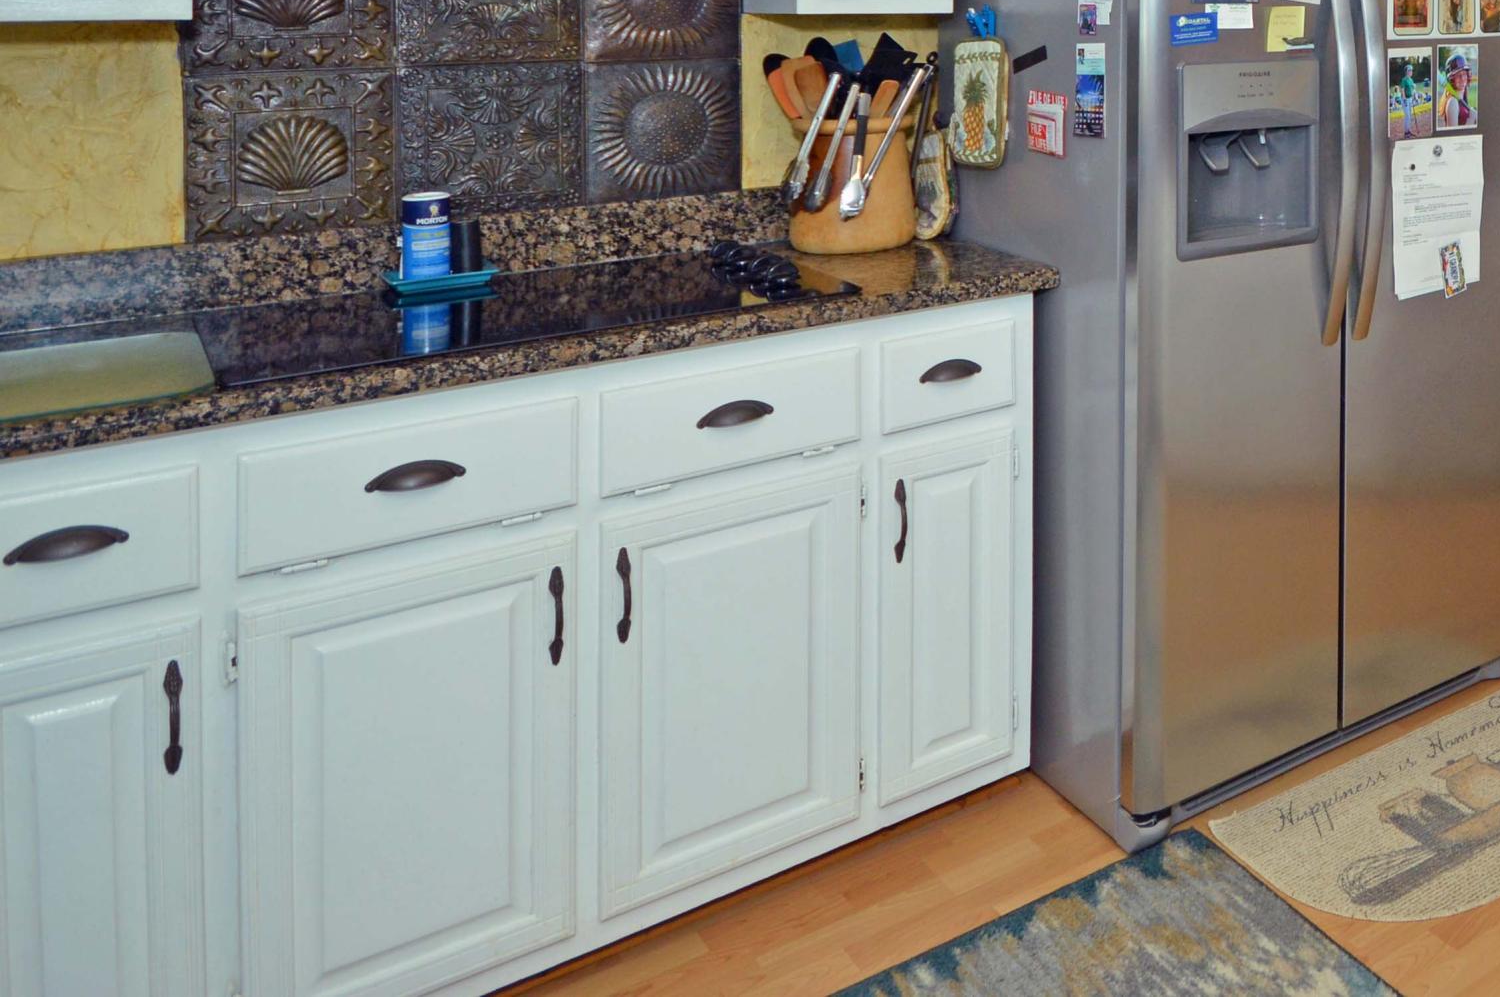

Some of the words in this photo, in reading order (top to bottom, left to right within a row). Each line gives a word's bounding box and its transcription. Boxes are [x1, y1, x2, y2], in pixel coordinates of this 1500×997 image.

[416, 215, 449, 225] MORTON
[1274, 770, 1388, 837] Happiness
[1397, 756, 1417, 773] is
